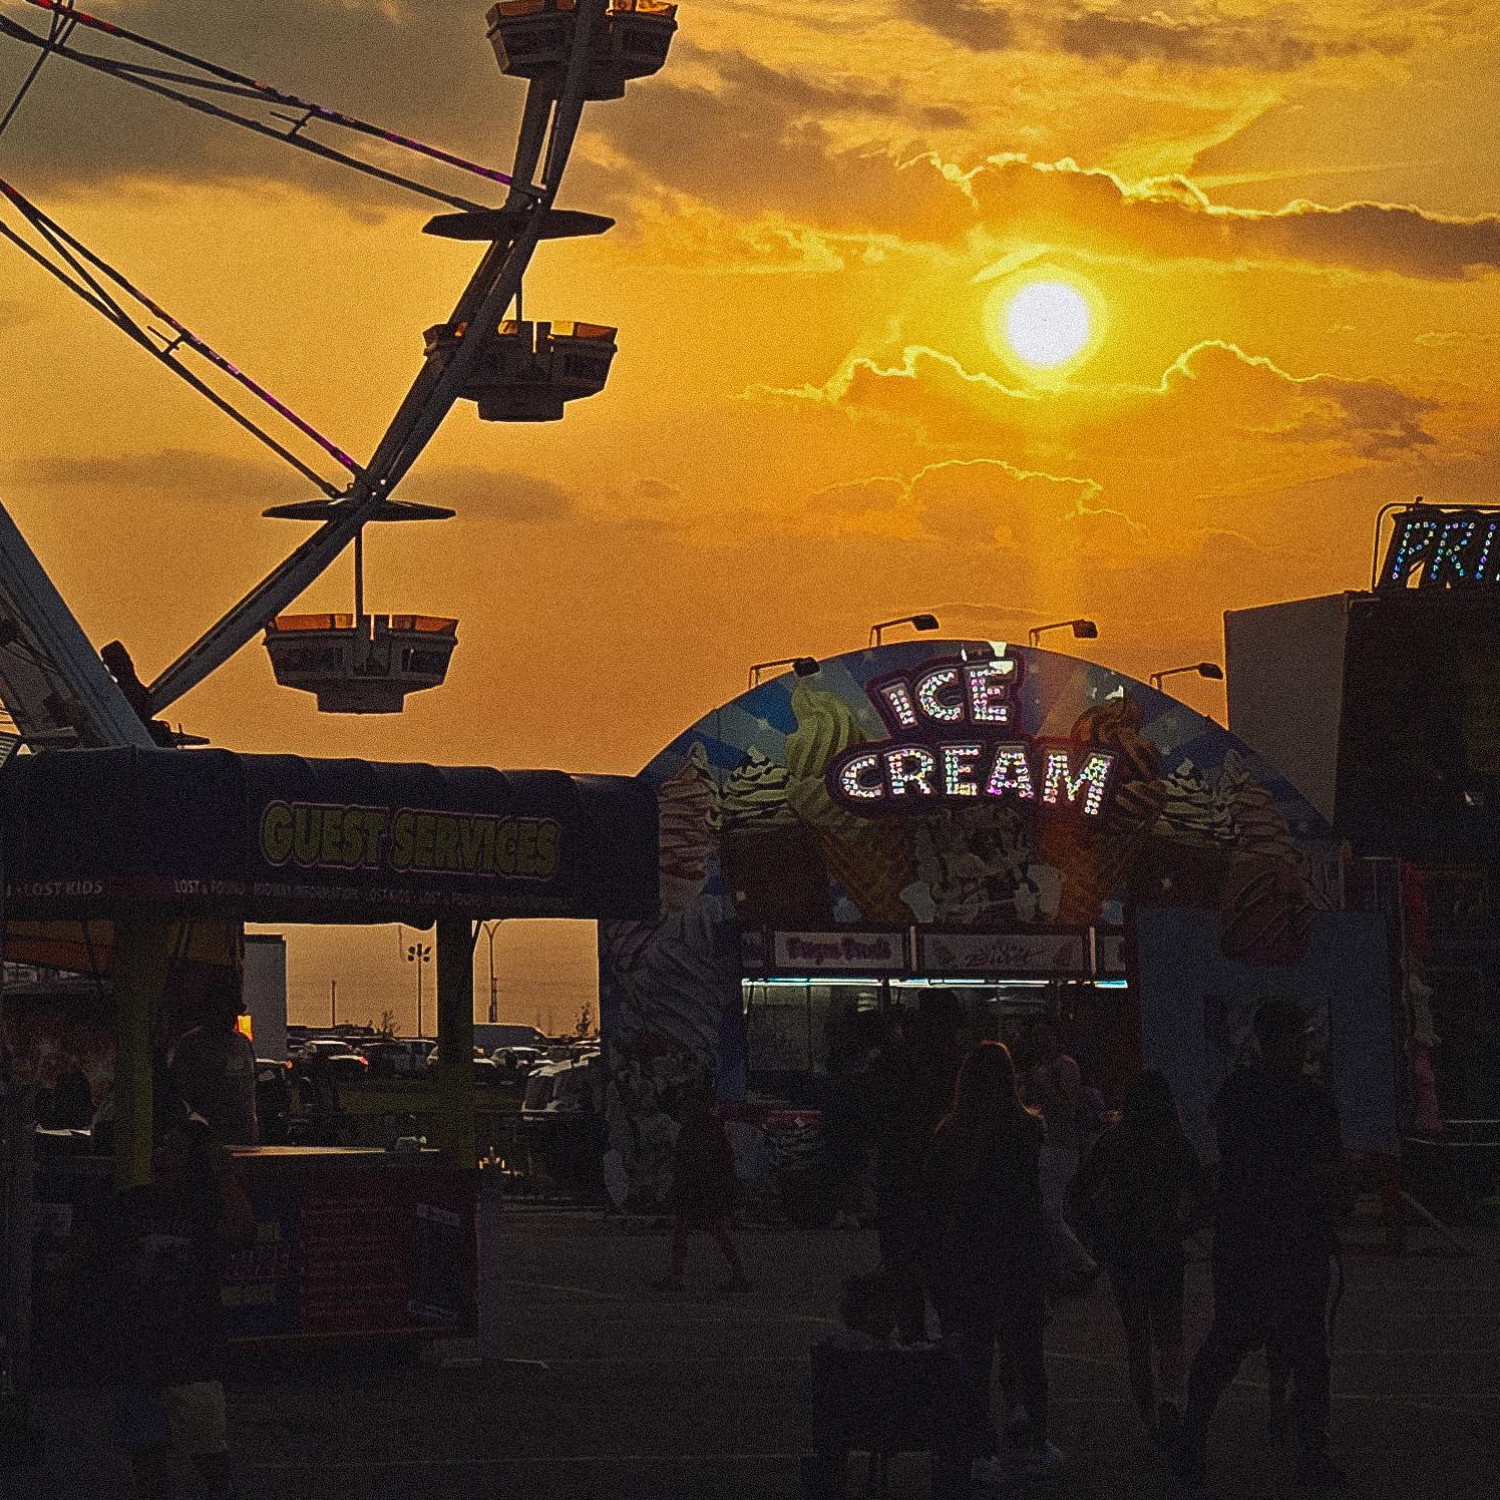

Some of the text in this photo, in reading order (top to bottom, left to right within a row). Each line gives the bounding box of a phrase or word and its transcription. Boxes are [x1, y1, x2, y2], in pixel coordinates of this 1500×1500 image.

[1390, 519, 1500, 582] PRI
[881, 659, 1018, 728] ICE
[838, 743, 1114, 816] CREAM
[261, 801, 562, 880] GUEST SERVICES
[23, 881, 63, 897] LOST
[65, 879, 105, 896] KIDS
[173, 878, 201, 895] LOST
